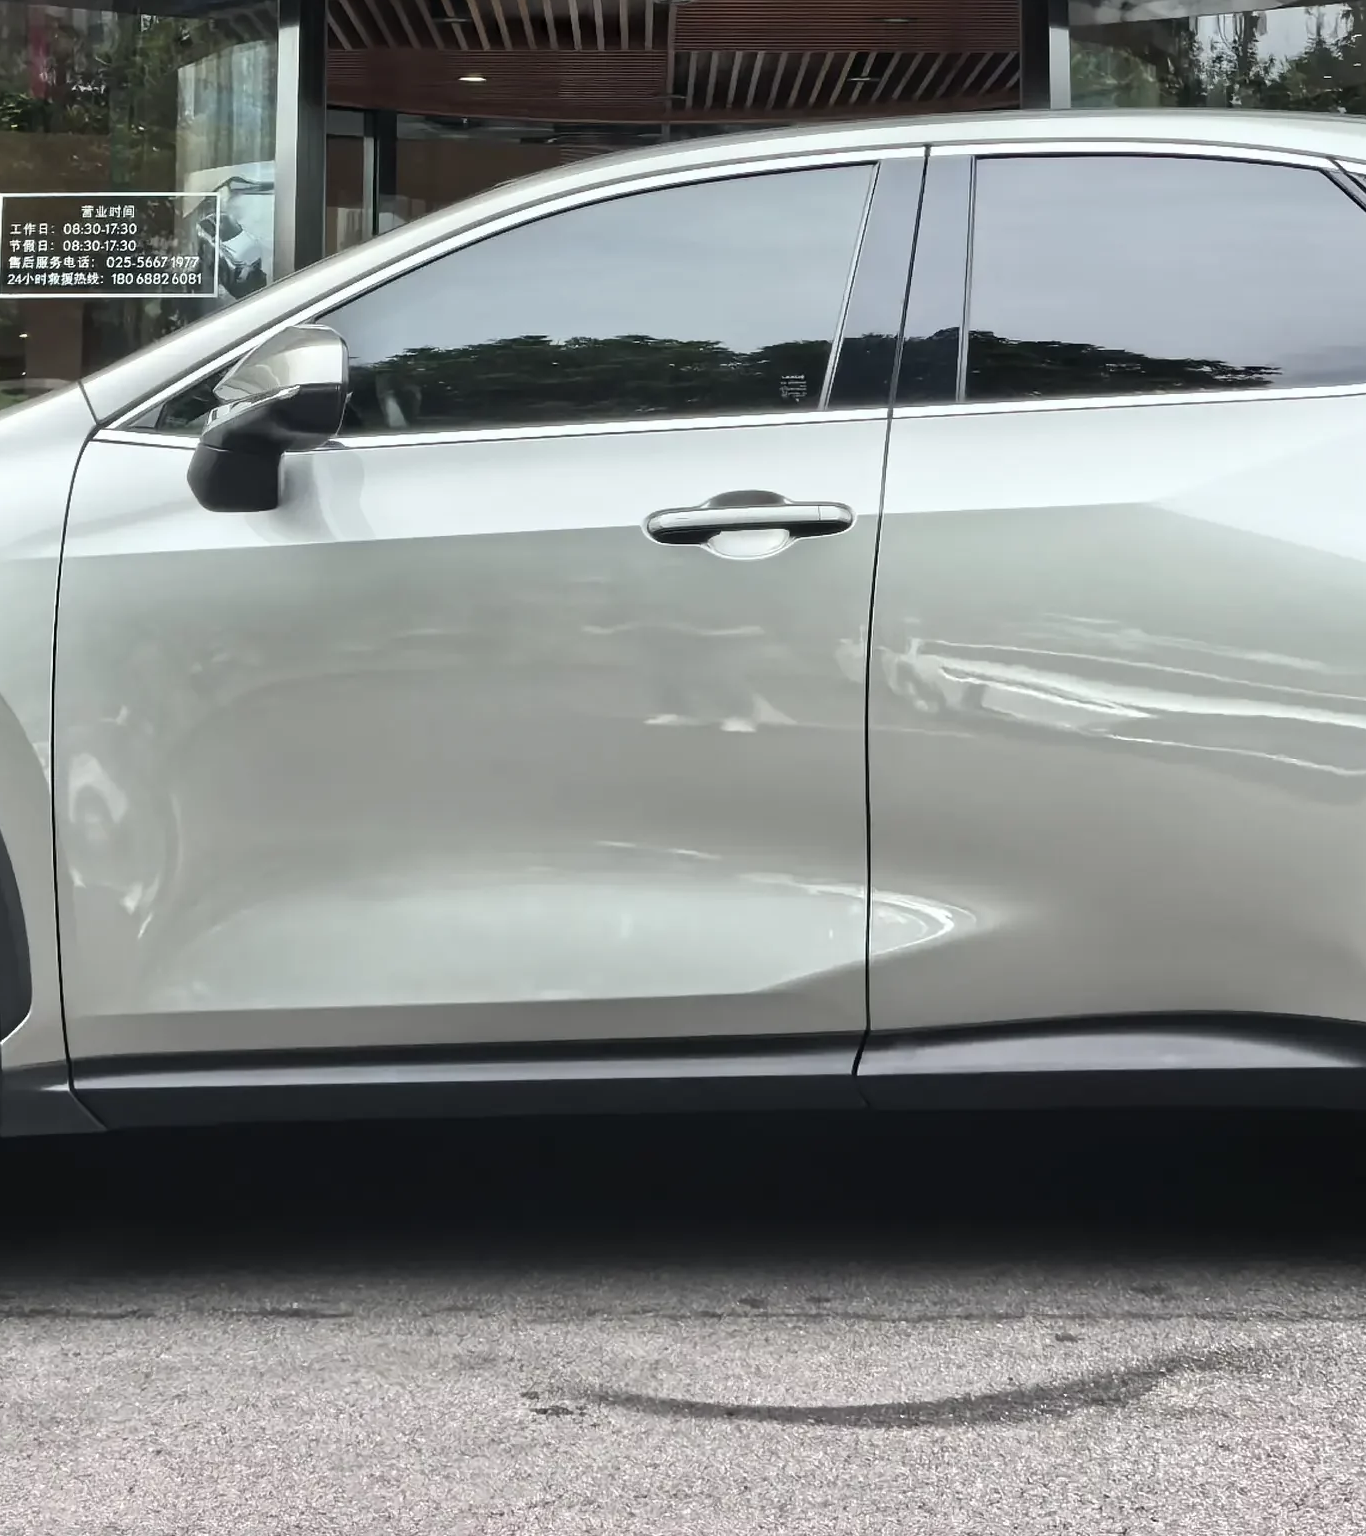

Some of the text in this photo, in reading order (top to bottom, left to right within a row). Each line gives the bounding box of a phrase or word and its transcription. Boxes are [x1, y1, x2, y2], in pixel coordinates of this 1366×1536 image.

[81, 205, 135, 218] 营业时间
[63, 223, 137, 235] 08:30-17:30
[63, 240, 137, 252] 08:30-17:30
